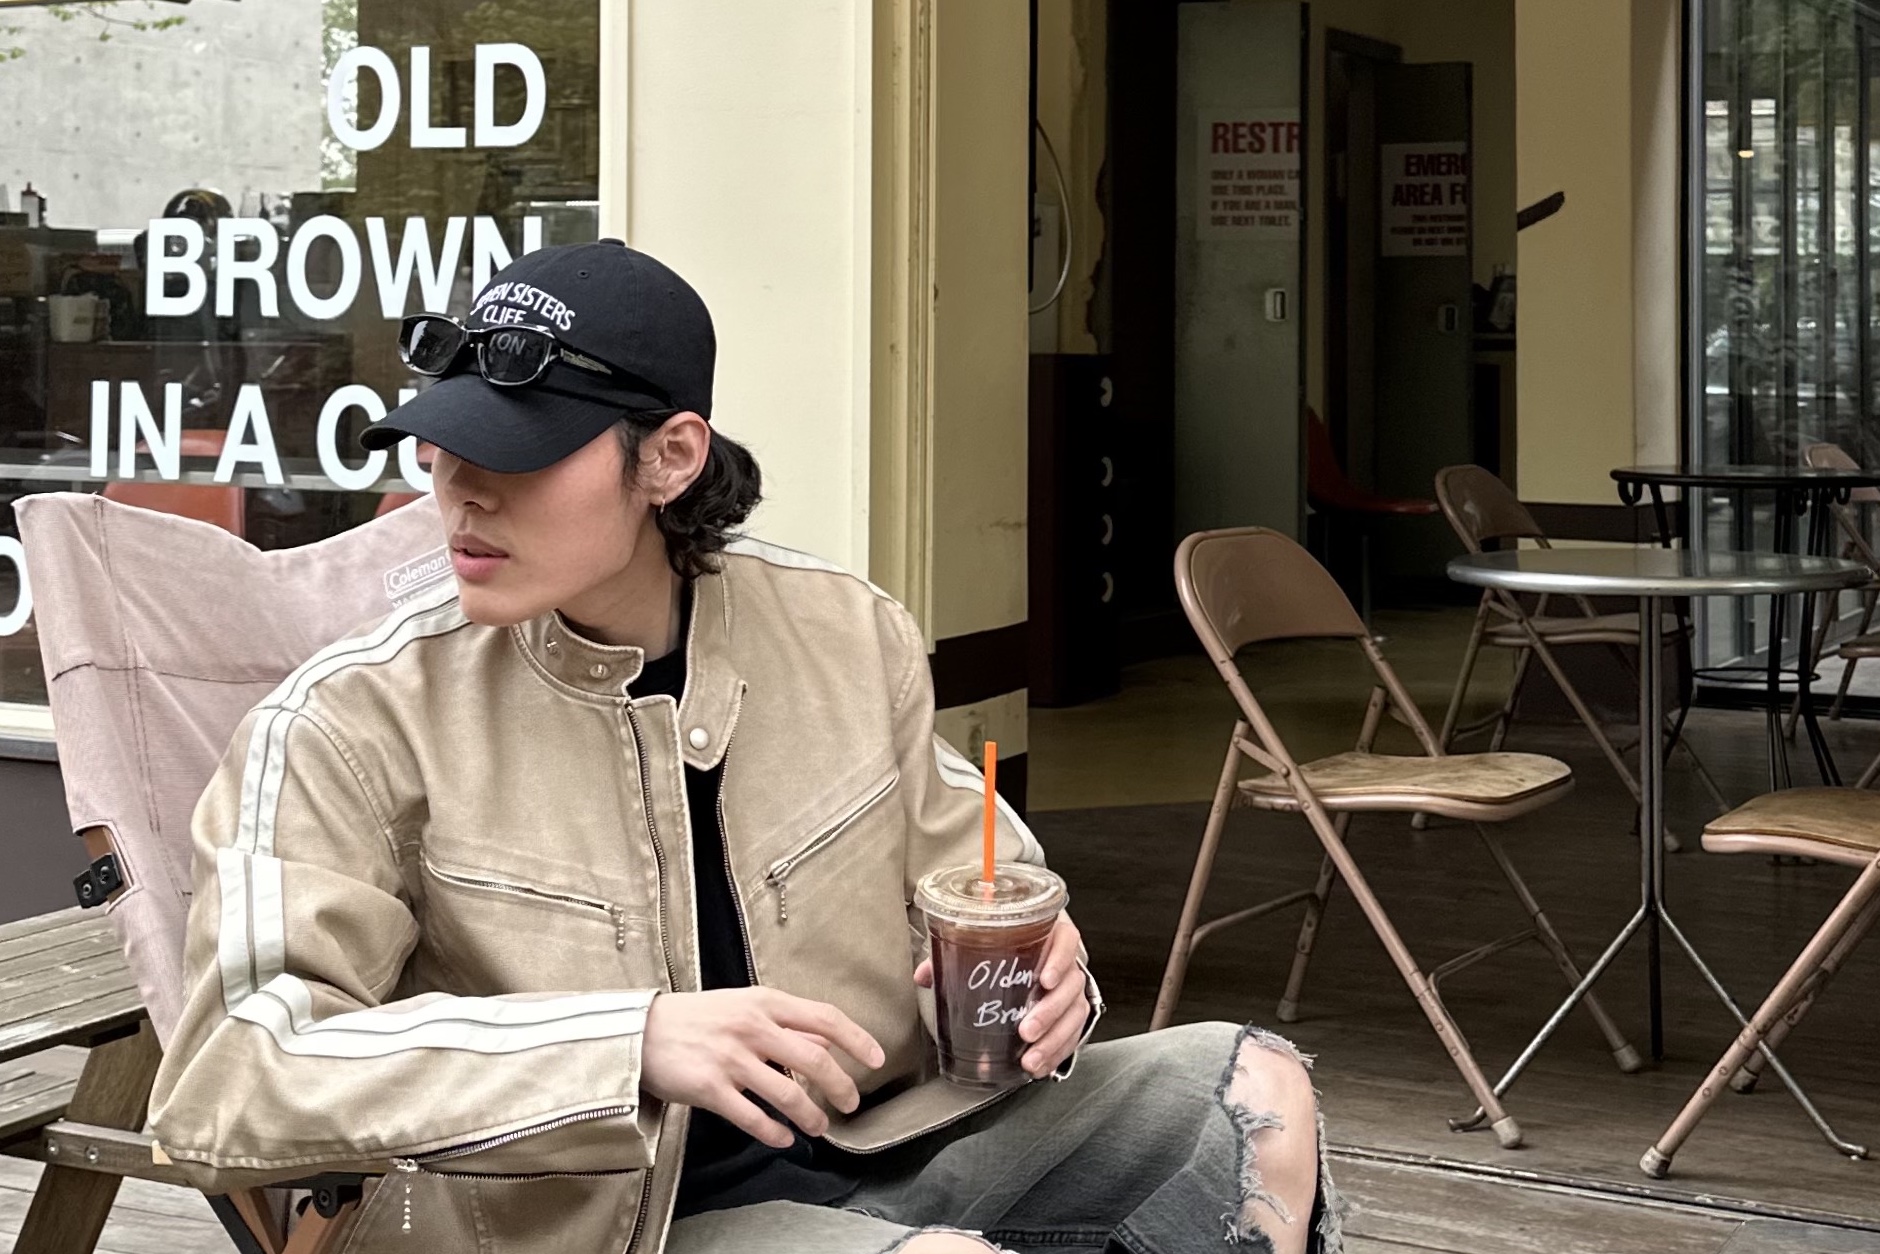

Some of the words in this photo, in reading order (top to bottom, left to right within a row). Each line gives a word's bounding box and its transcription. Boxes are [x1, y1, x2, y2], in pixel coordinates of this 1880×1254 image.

[327, 43, 547, 151] OLD
[1392, 183, 1443, 206] AREA
[482, 304, 527, 324] CLIFF
[507, 282, 576, 331] SISTERS
[90, 380, 182, 480] IN
[214, 384, 286, 485] A
[389, 556, 446, 589] Coleman
[967, 956, 1034, 991] Olden
